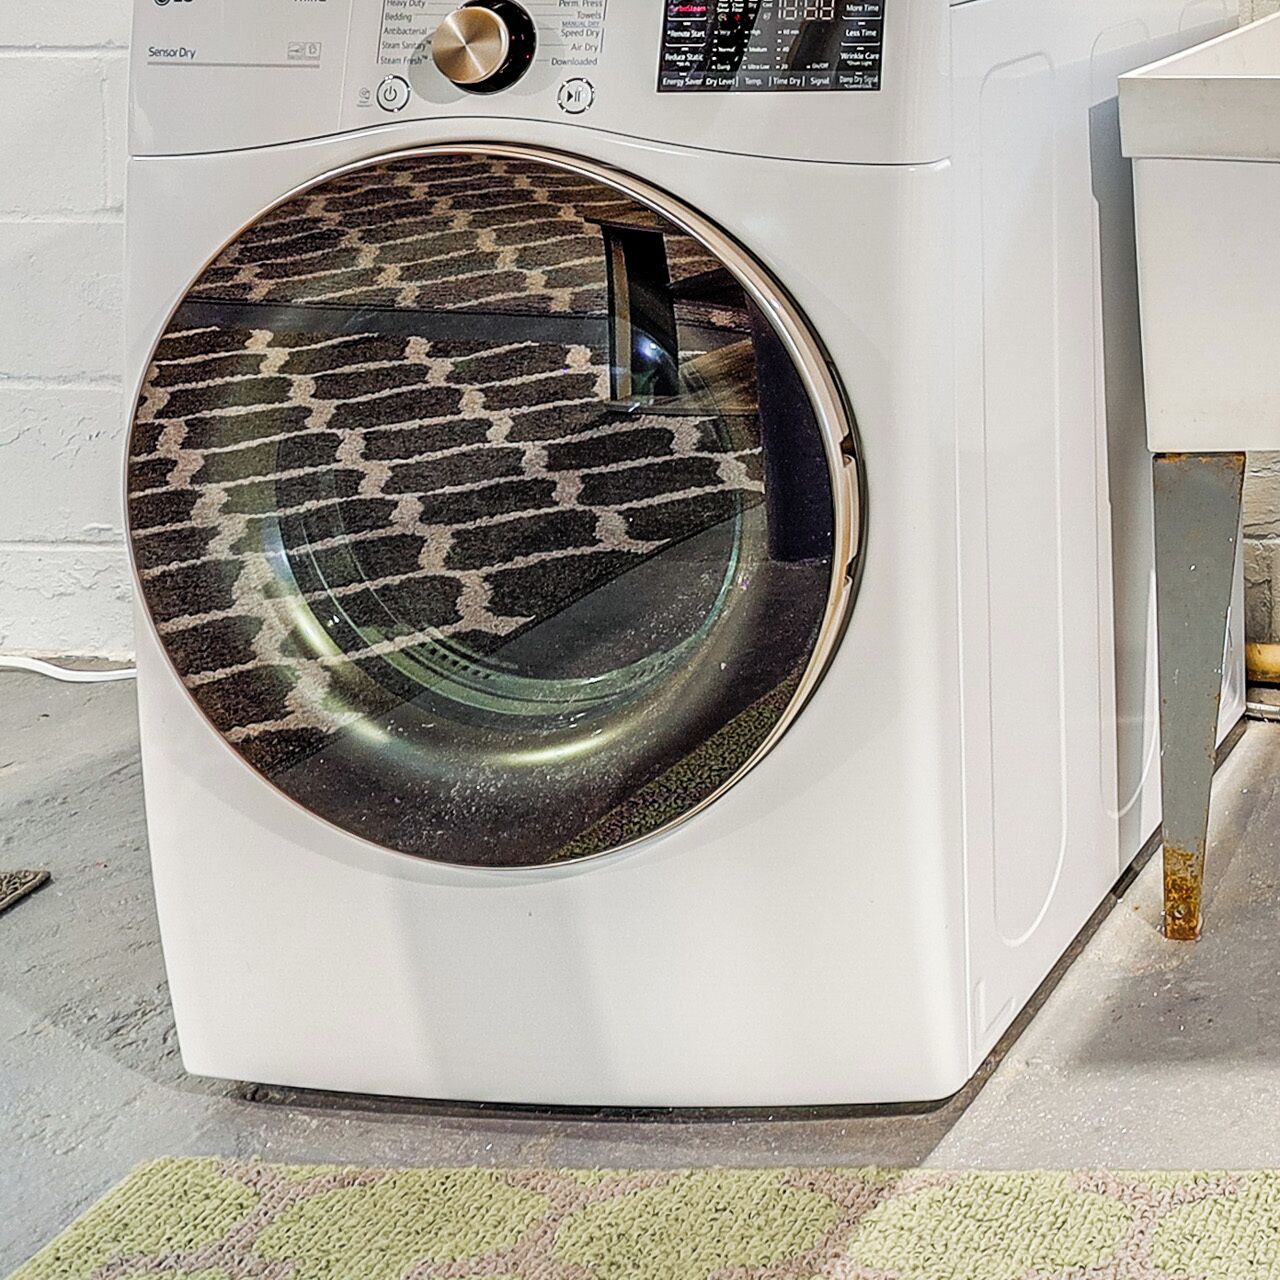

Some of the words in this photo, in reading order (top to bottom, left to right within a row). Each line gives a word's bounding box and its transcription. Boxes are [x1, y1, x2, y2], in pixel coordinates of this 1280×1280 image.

[582, 0, 602, 7] Press
[846, 4, 862, 12] More
[864, 4, 879, 12] Time
[385, 12, 412, 22] Bedding
[577, 11, 602, 19] Towels
[561, 28, 584, 38] Speed
[586, 29, 600, 38] Dry
[690, 30, 706, 38] Start
[382, 41, 400, 49] Steam
[584, 43, 598, 53] Dry
[380, 56, 401, 64] Steam
[840, 52, 864, 60] Wrinkle
[864, 52, 880, 60] Care
[551, 58, 598, 66] Downloaded
[662, 77, 684, 87] Energy
[685, 77, 704, 85] Saver
[706, 78, 717, 87] Dry
[789, 77, 800, 86] Dry
[810, 76, 830, 86] Signal
[854, 76, 863, 84] Dry
[864, 76, 878, 84] Signal
